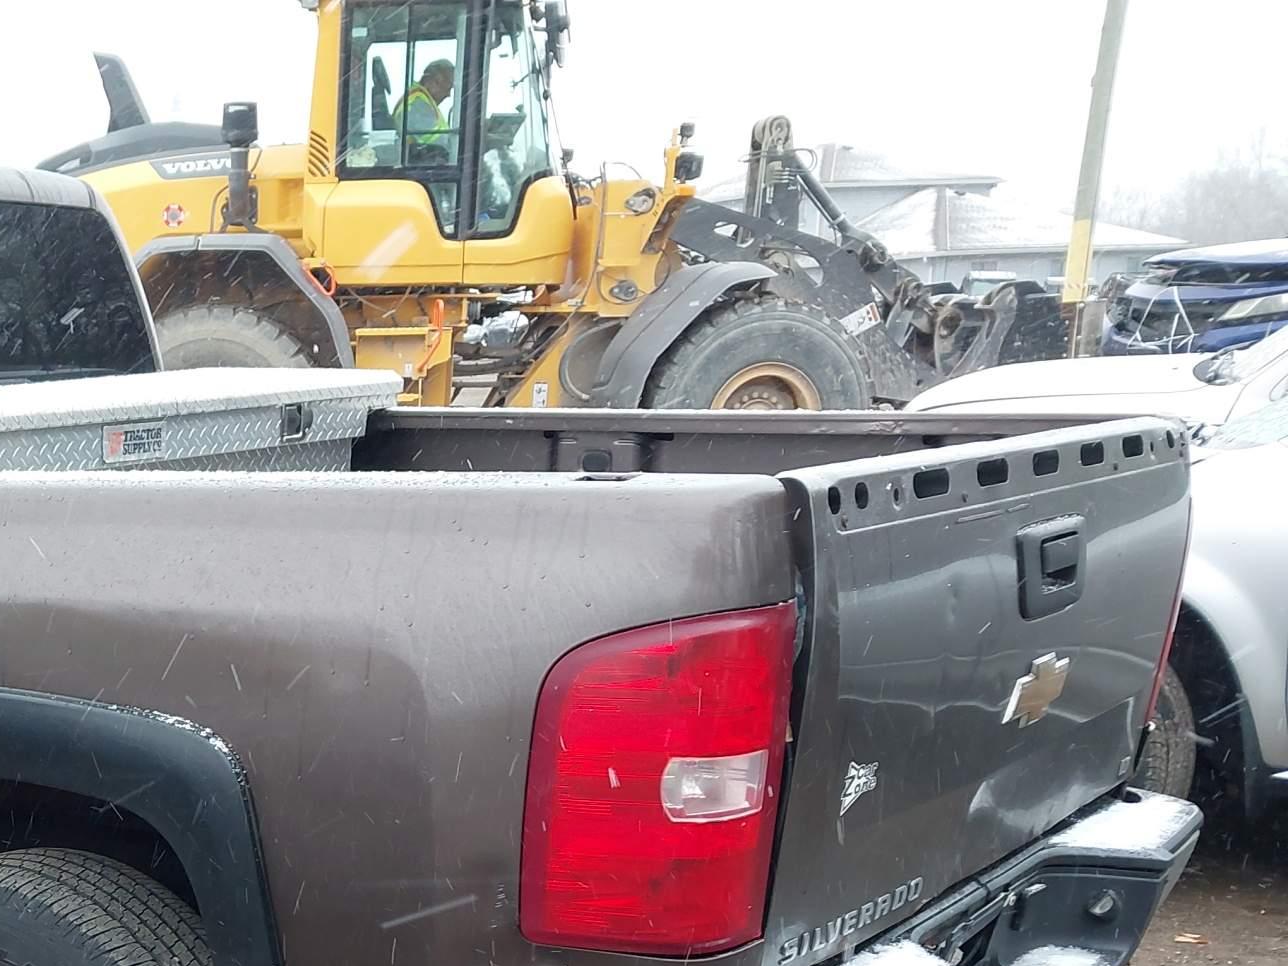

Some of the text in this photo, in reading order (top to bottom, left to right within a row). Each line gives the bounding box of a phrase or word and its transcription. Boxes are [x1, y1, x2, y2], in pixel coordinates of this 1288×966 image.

[123, 427, 162, 443] TRACTOR
[122, 441, 152, 456] SUPPLY
[777, 876, 924, 966] SILVERADO
